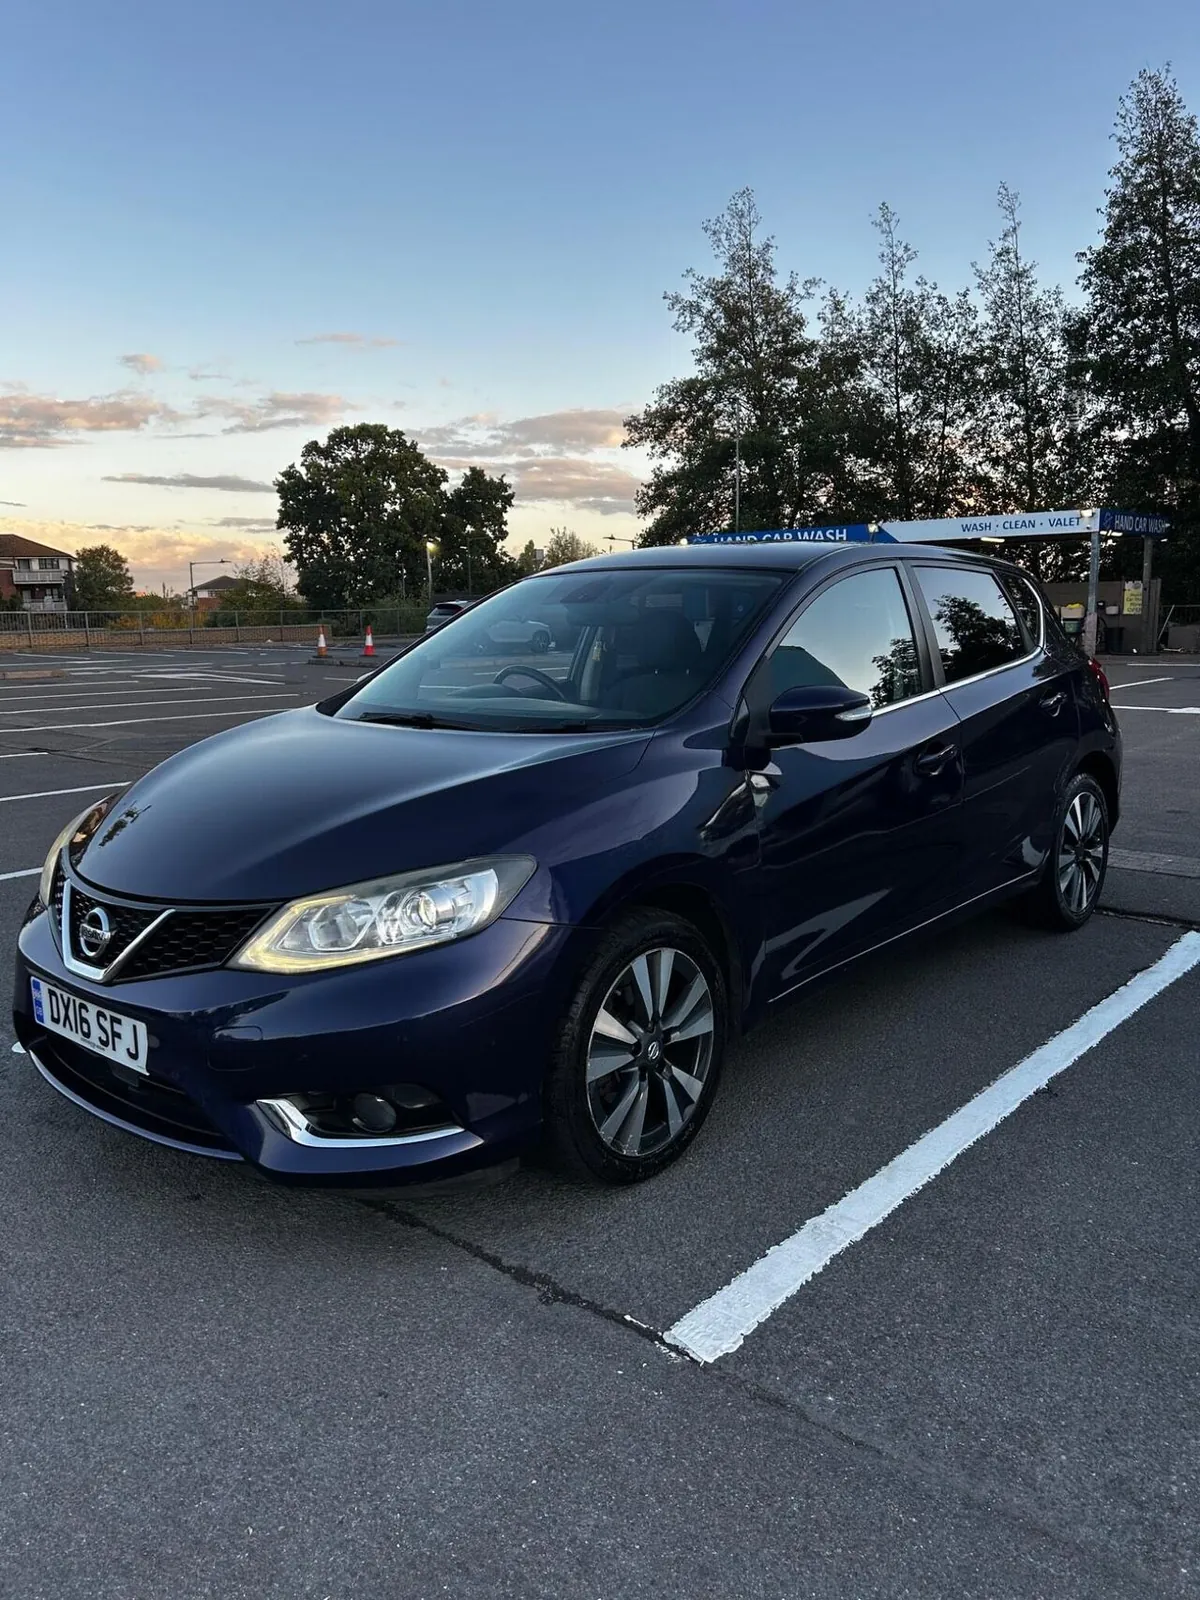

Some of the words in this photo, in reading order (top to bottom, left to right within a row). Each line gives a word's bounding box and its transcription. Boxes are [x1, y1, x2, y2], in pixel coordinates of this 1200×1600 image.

[961, 522, 992, 533] WASH
[1002, 520, 1036, 530] CLEAN
[1048, 516, 1081, 527] VALET
[1114, 514, 1134, 531] HAND
[1134, 516, 1147, 532] CAR
[1148, 518, 1167, 533] WASH
[798, 529, 847, 541] WASH
[47, 987, 92, 1039] DX16
[96, 1009, 139, 1061] SFJ
